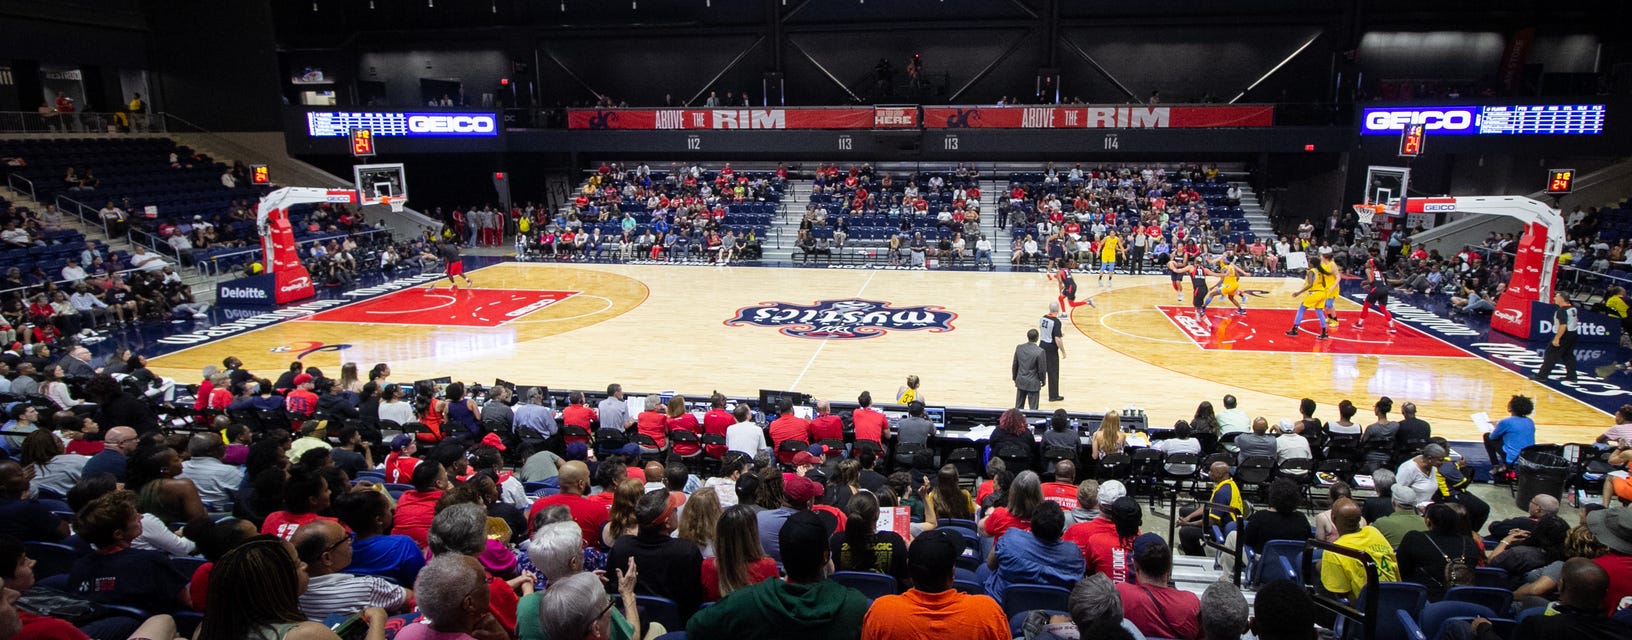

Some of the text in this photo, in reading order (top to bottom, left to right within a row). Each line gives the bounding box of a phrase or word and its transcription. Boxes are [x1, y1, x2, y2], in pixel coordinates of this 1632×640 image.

[408, 115, 494, 133] GEICO
[655, 109, 785, 129] ABOVE THE RIM
[875, 116, 912, 125] HERE
[1021, 107, 1170, 128] ABOVE THE RIM
[1365, 110, 1472, 130] GEICO
[355, 138, 370, 153] 24
[687, 138, 700, 150] 112
[838, 138, 852, 150] 113
[944, 138, 958, 150] 113
[1104, 137, 1119, 150] 114
[1405, 136, 1420, 152] 24
[1552, 180, 1567, 190] 24
[1042, 319, 1049, 329] 21
